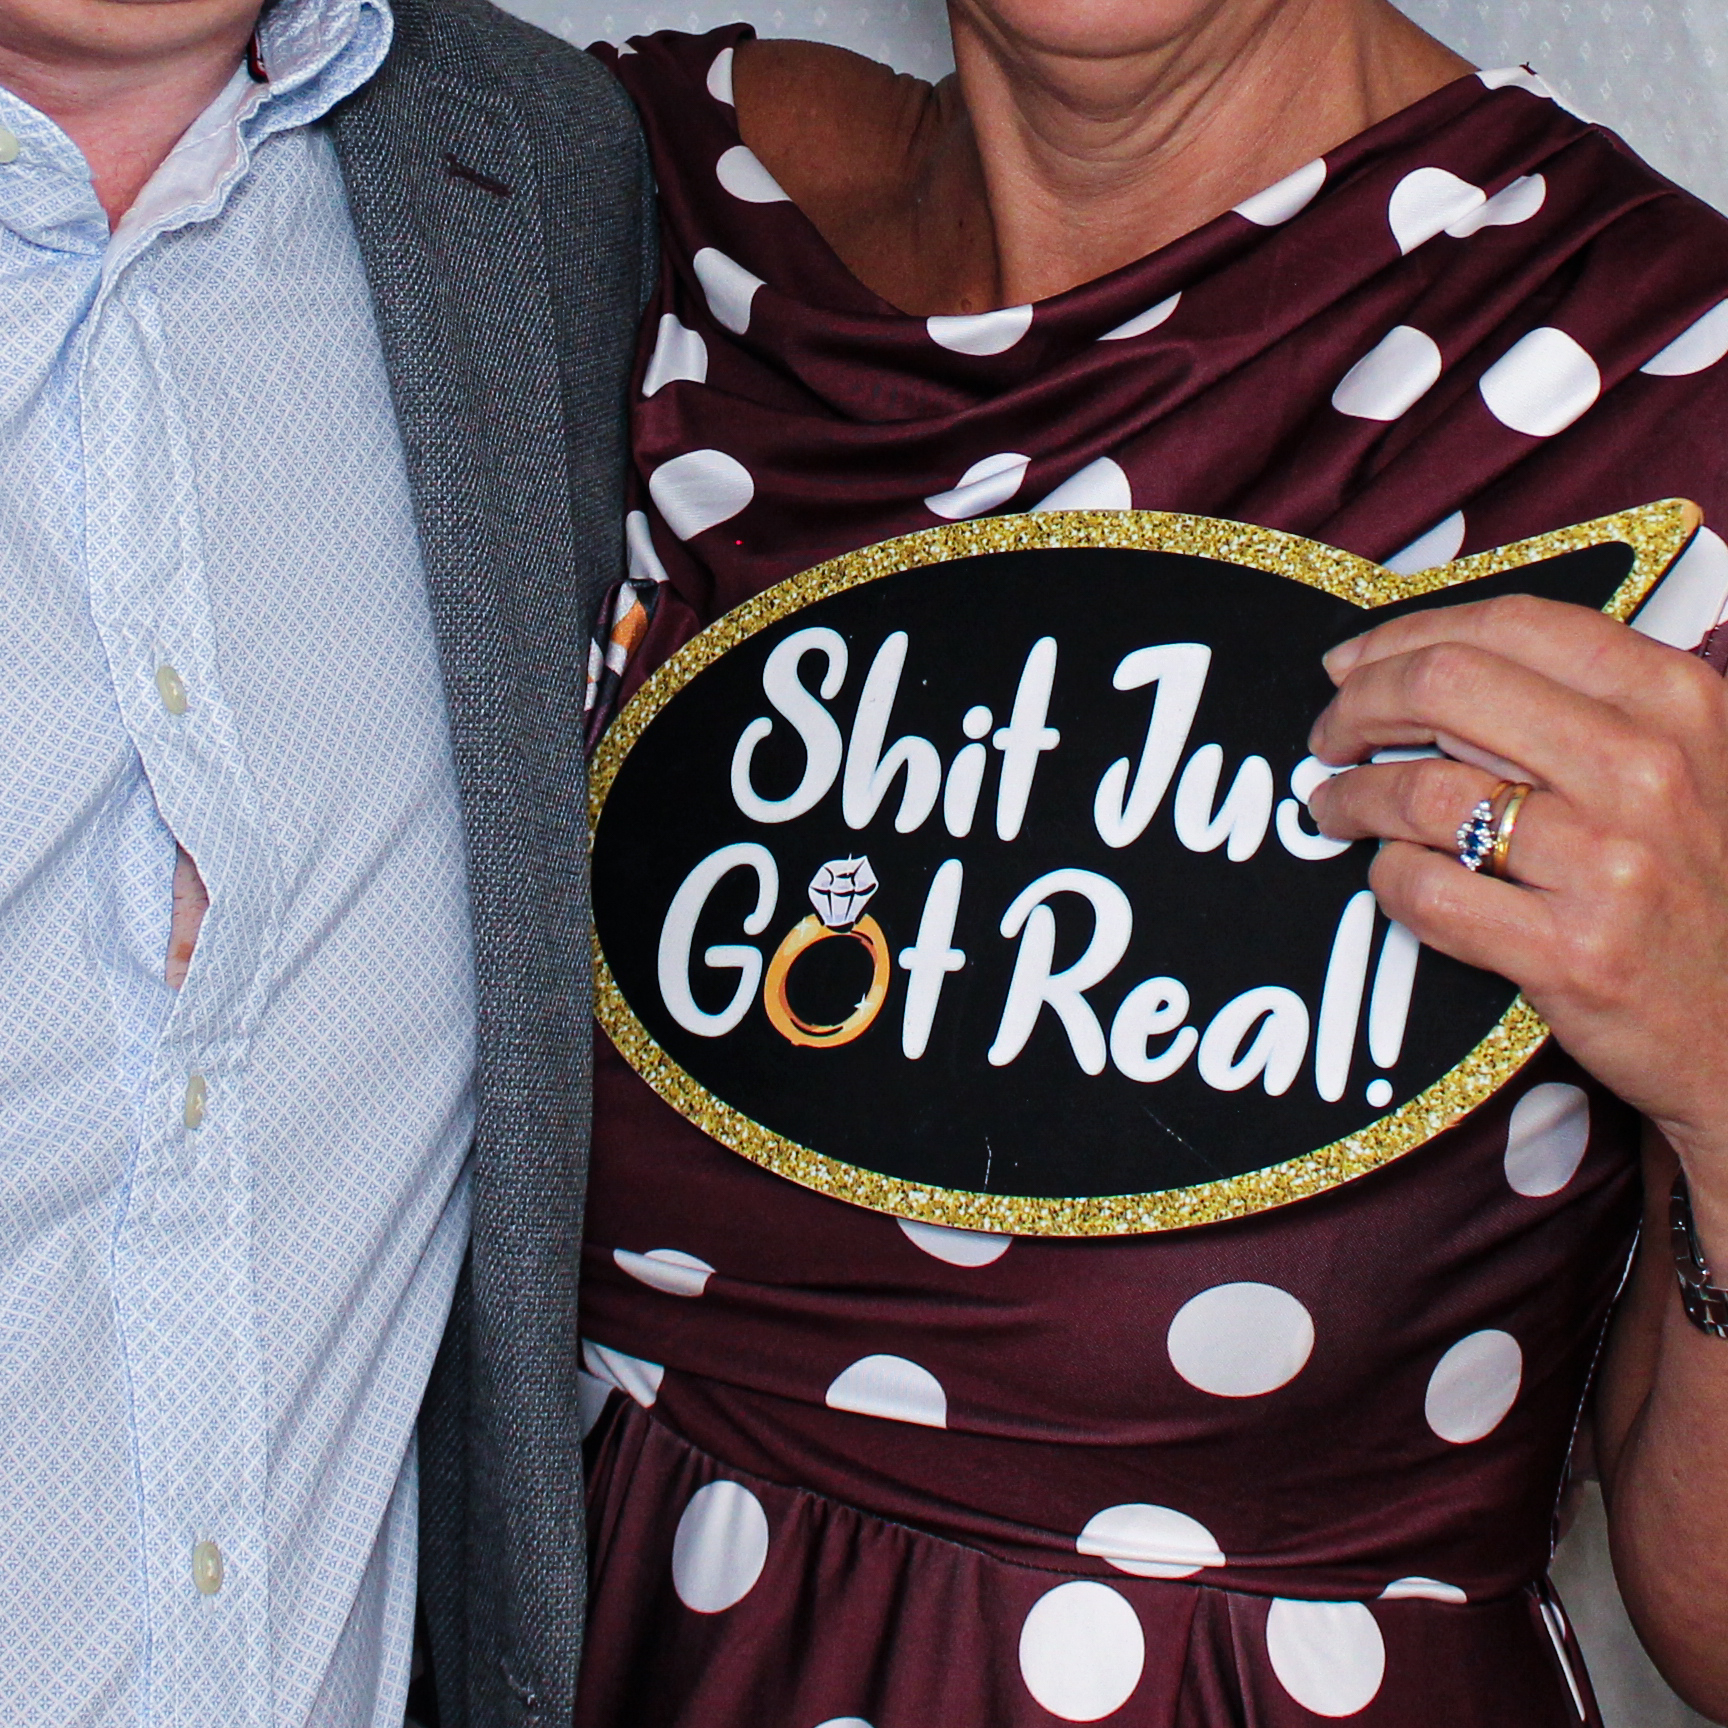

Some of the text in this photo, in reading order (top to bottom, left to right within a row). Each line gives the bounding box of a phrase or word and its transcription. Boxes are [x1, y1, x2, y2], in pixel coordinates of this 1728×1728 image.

[731, 626, 1444, 861] Shit Jus
[658, 842, 1420, 1108] Got Real!
